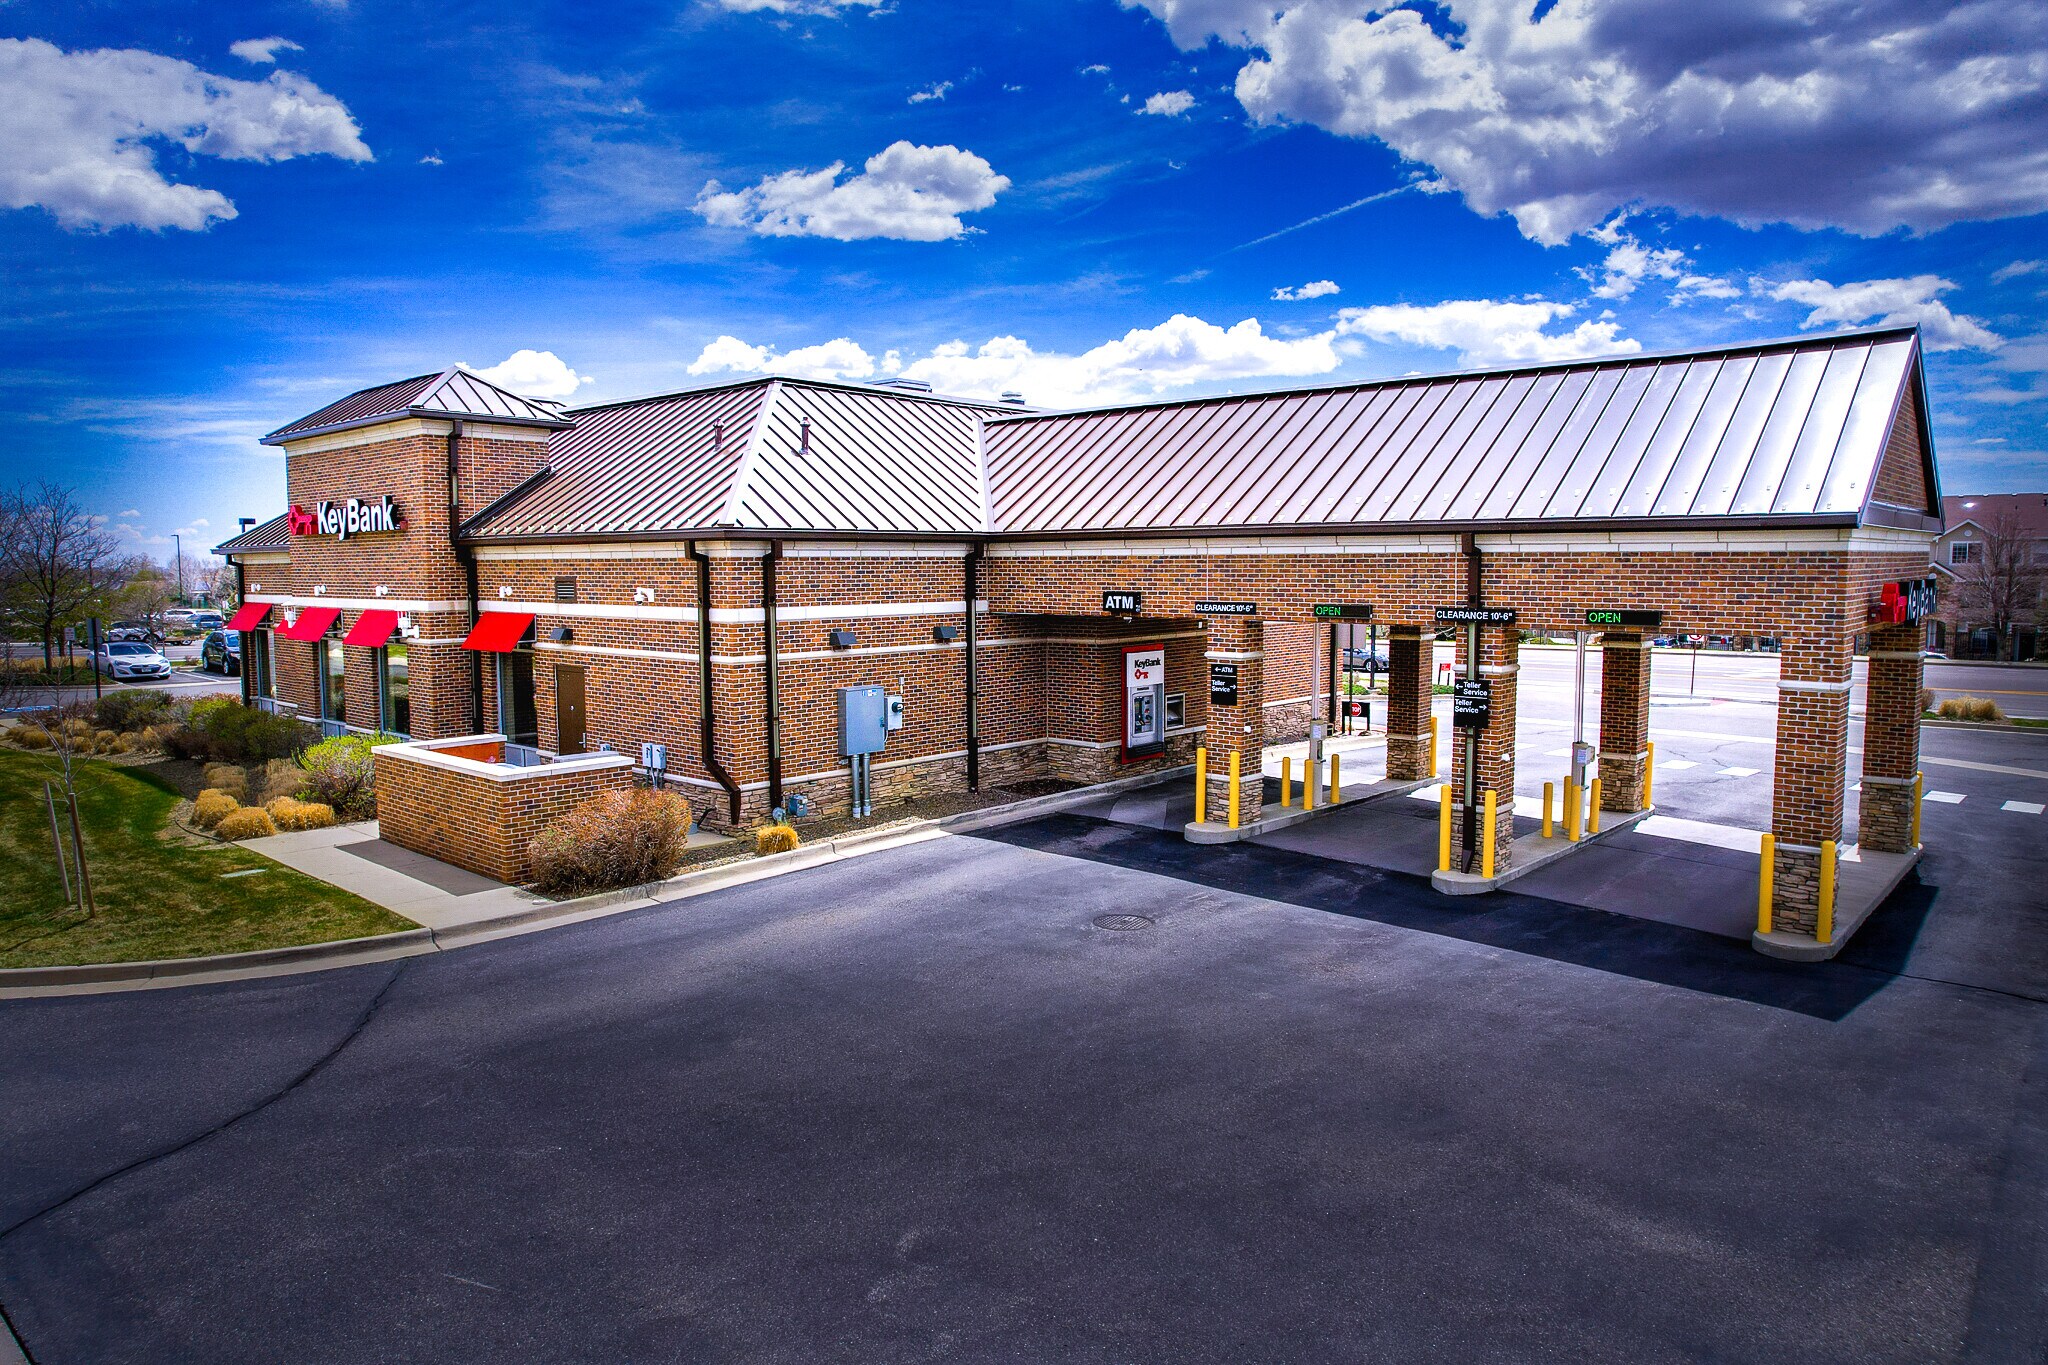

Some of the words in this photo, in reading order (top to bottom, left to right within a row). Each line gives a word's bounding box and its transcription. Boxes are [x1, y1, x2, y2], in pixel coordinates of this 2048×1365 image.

[317, 495, 395, 540] KeyBank
[1105, 595, 1134, 609] ATM
[1195, 603, 1236, 612] CLEARANCE
[1315, 606, 1341, 616] OPEN
[1436, 610, 1489, 620] CLEARANCE
[1588, 612, 1621, 623] OPEN
[1134, 657, 1161, 669] KeyBank
[1211, 685, 1231, 693] Service
[1463, 681, 1481, 689] Teller
[1463, 688, 1488, 696] Service
[1454, 698, 1473, 706] Teller
[1454, 705, 1479, 714] Service
